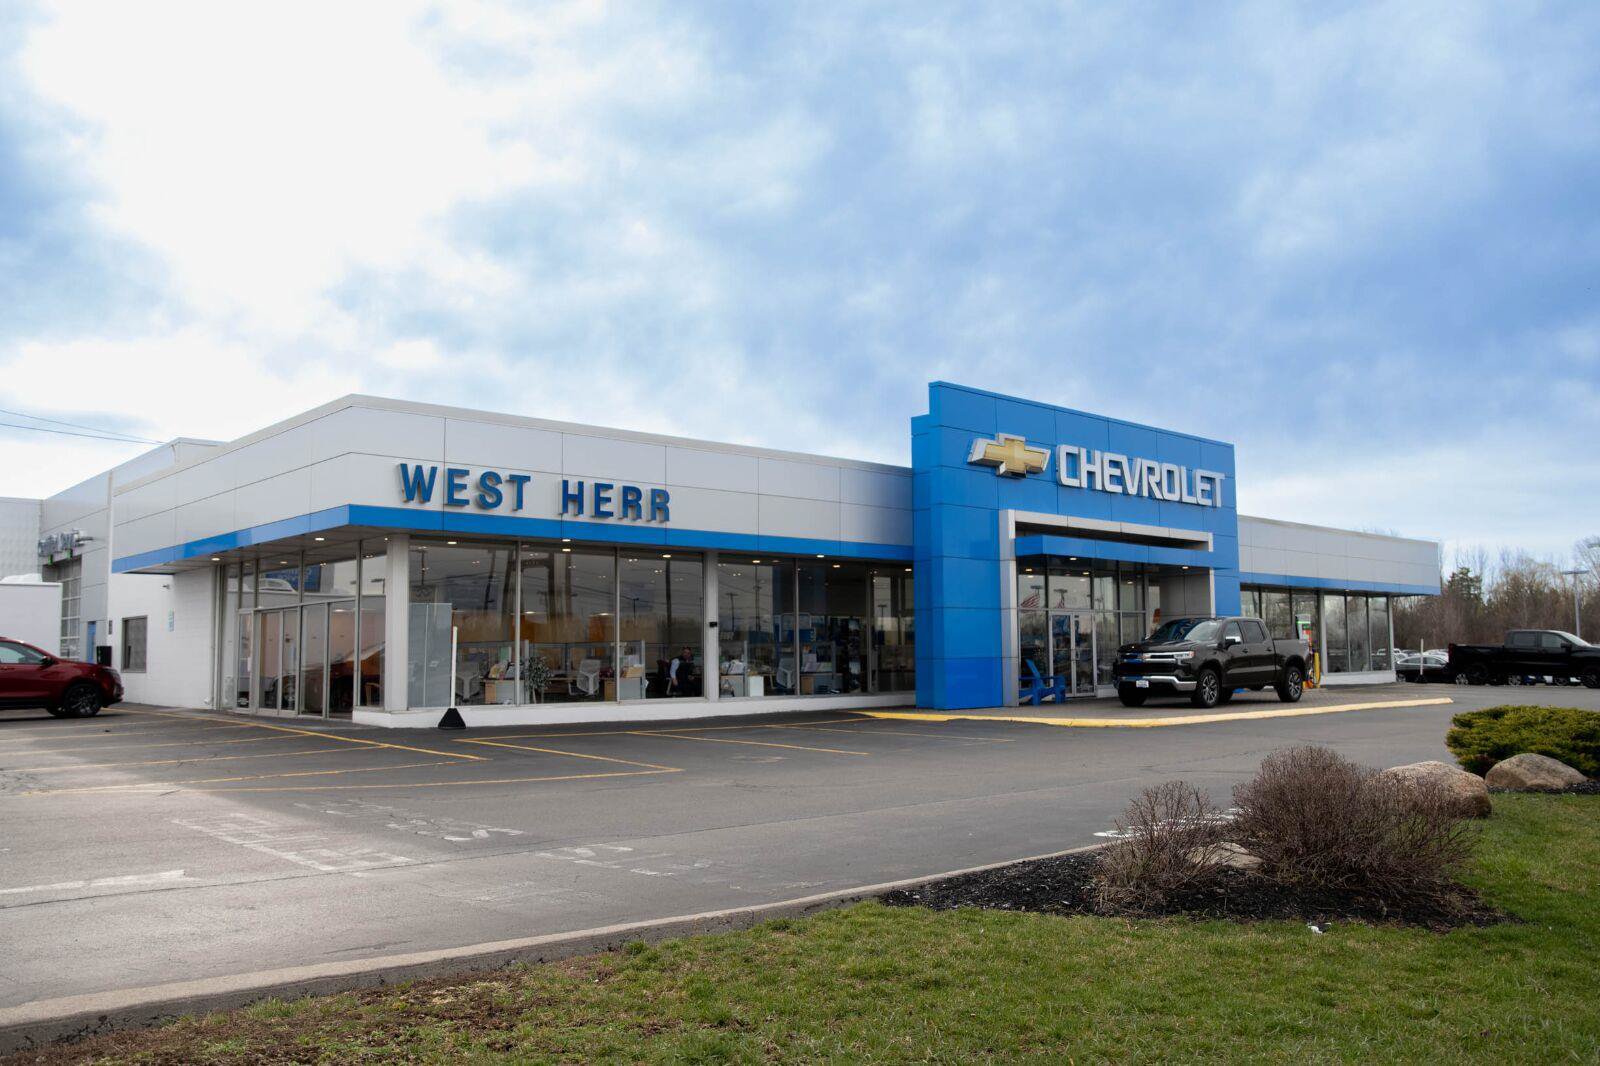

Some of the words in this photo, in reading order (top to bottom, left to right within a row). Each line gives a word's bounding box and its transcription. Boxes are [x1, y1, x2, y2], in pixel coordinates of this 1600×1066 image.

[399, 463, 531, 511] WEST
[560, 479, 671, 523] HERR
[1057, 444, 1225, 508] CHEVROLET
